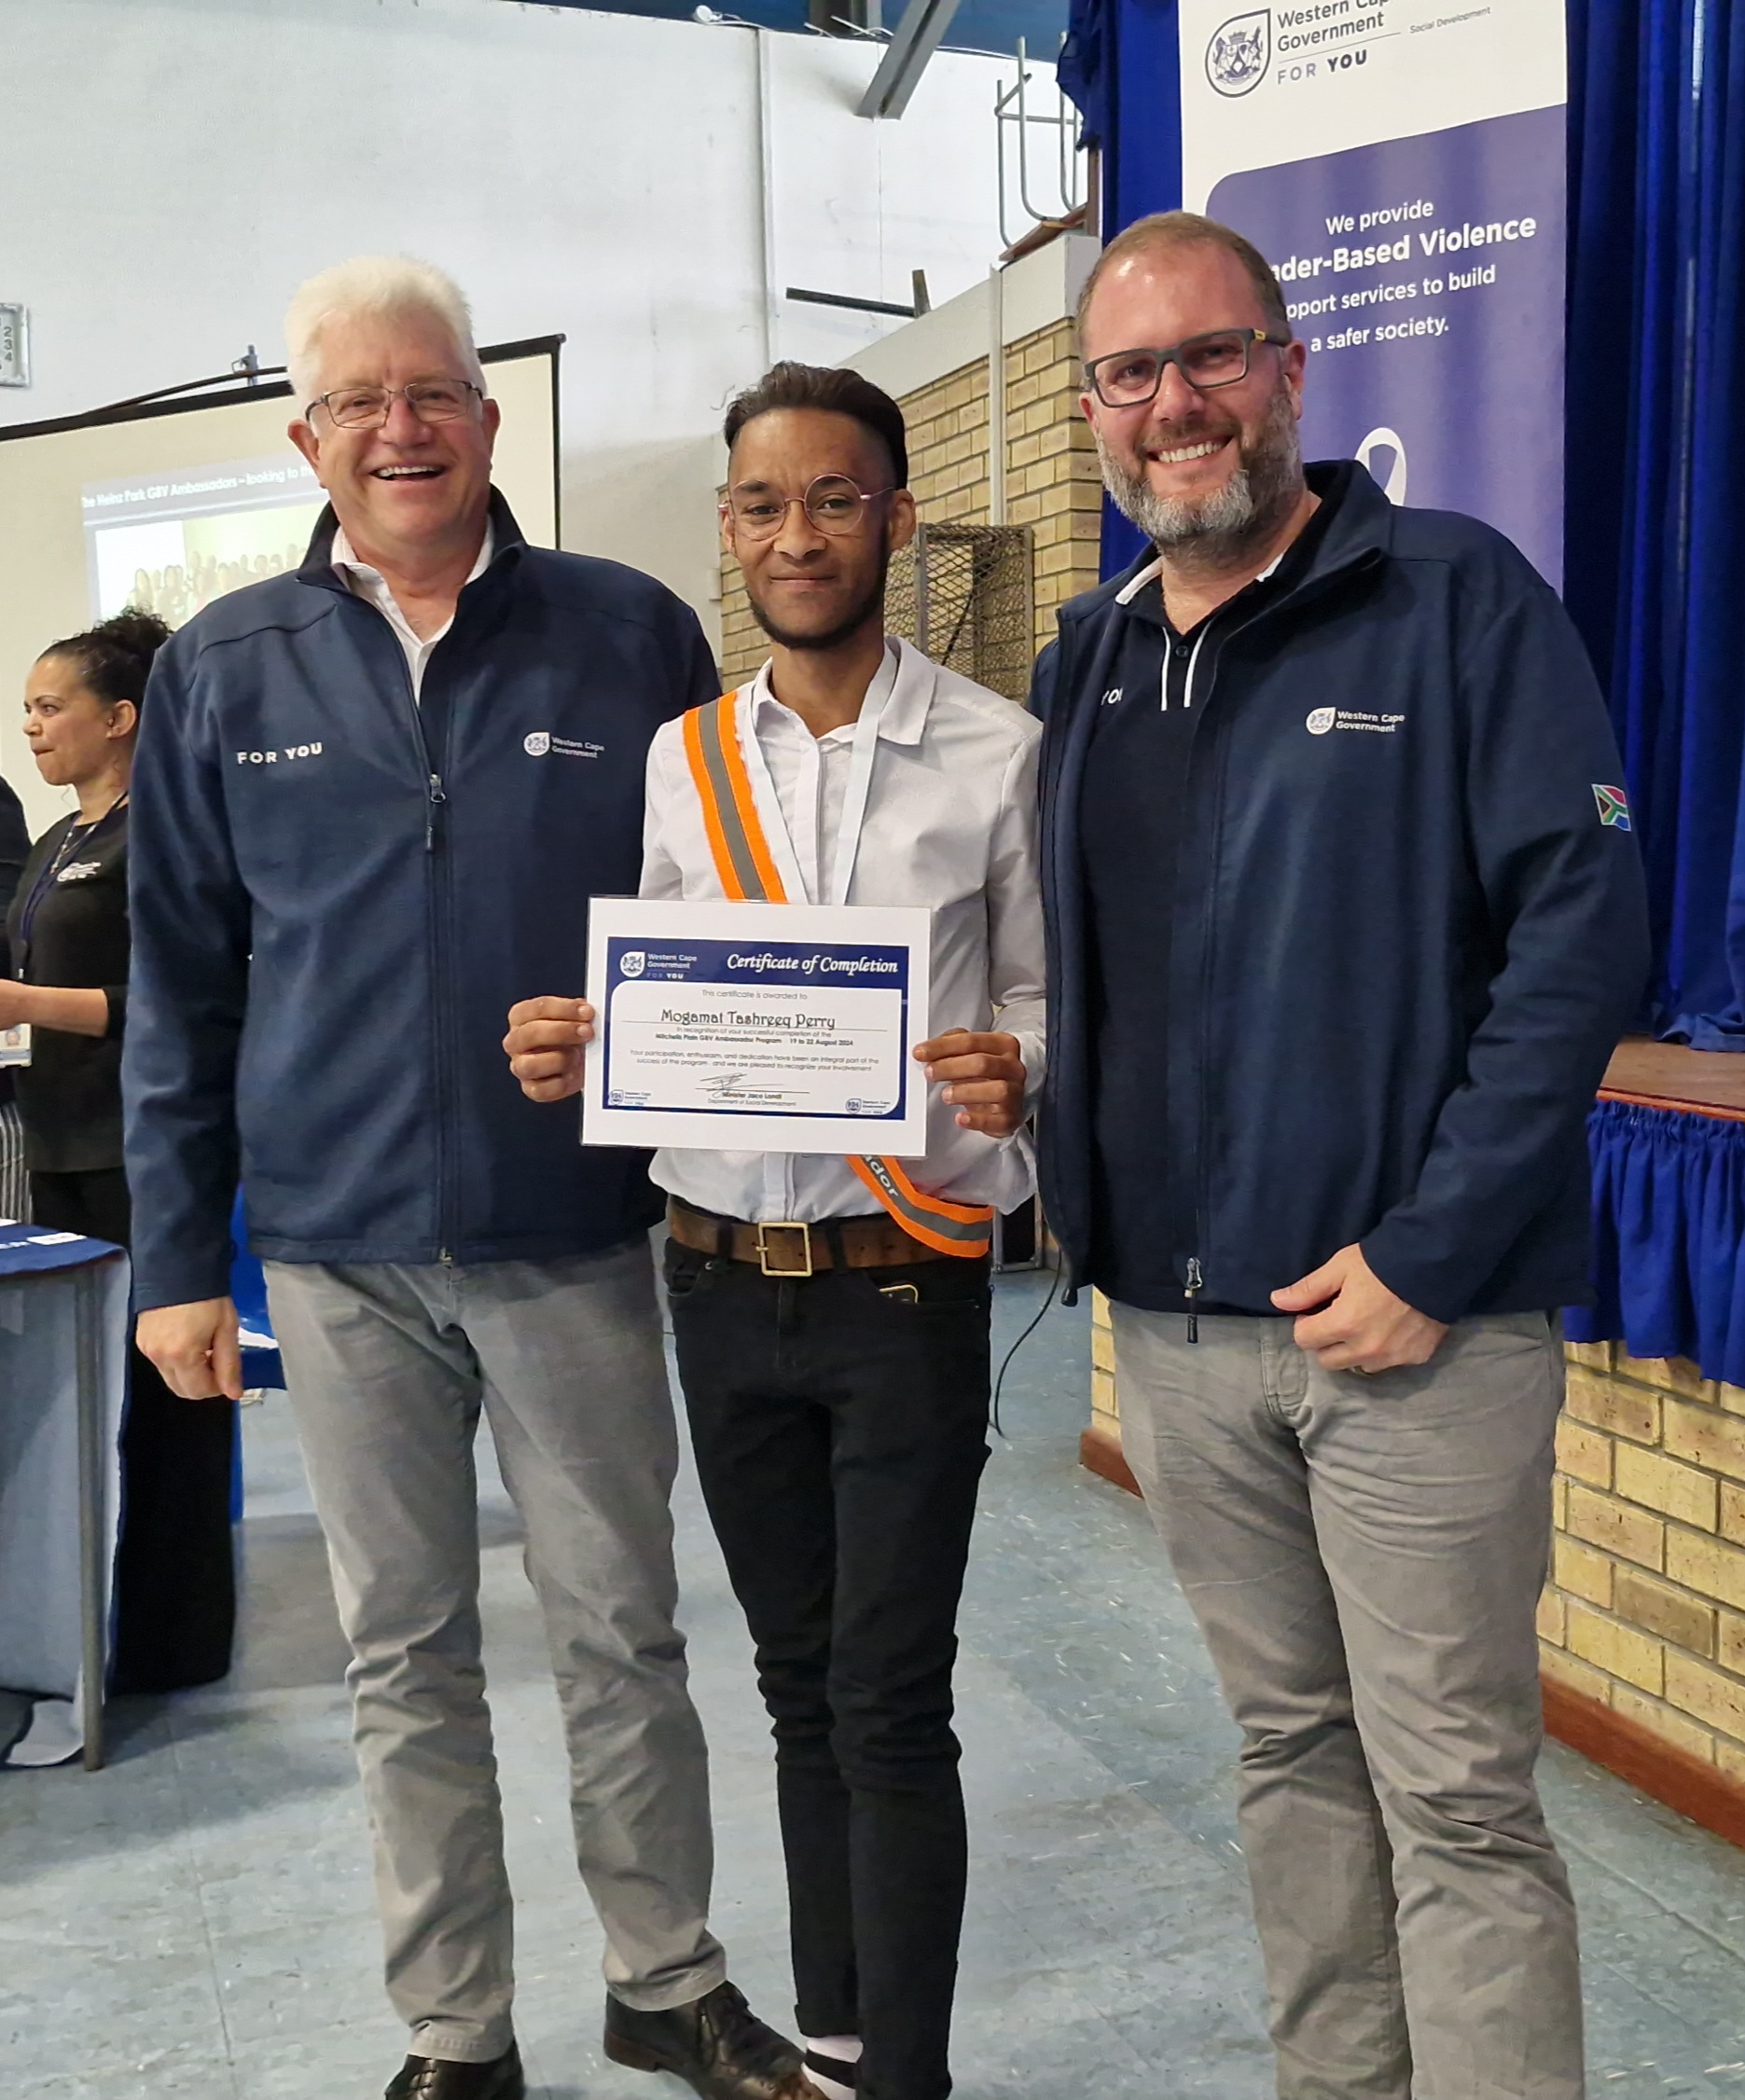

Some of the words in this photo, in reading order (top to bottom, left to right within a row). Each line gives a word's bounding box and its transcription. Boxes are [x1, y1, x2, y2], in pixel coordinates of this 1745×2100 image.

[1277, 0, 1350, 29] Western
[1410, 21, 1434, 35] Social
[1436, 7, 1491, 28] Development
[1277, 11, 1385, 52] Government
[1277, 62, 1317, 85] FOR
[1327, 49, 1368, 73] YOU
[1325, 214, 1355, 235] We
[1359, 199, 1434, 232] provide
[1419, 216, 1537, 256] Violence
[1286, 294, 1336, 322] pport
[1341, 282, 1417, 310] services
[1422, 277, 1443, 296] to
[1448, 265, 1496, 291] build
[1310, 337, 1322, 352] a
[1326, 326, 1370, 351] safer
[1375, 315, 1450, 342] society.
[171, 476, 238, 497] Ambassadors
[287, 466, 298, 479] to
[1336, 721, 1396, 732] Government
[1337, 711, 1379, 722] Western
[1381, 714, 1406, 724] Cape
[236, 751, 277, 765] FOR
[284, 742, 322, 760] YOU
[551, 736, 583, 748] Western
[585, 742, 605, 752] Cape
[551, 746, 599, 759] Government
[647, 961, 691, 969] Government
[727, 953, 799, 973] Certificate
[801, 955, 820, 975] of
[820, 956, 898, 976] Completion
[702, 989, 715, 998] This
[716, 990, 755, 999] certificate
[661, 1009, 723, 1026] Mogamat
[727, 1011, 791, 1028] Tashreeq
[795, 1014, 836, 1030] Perry
